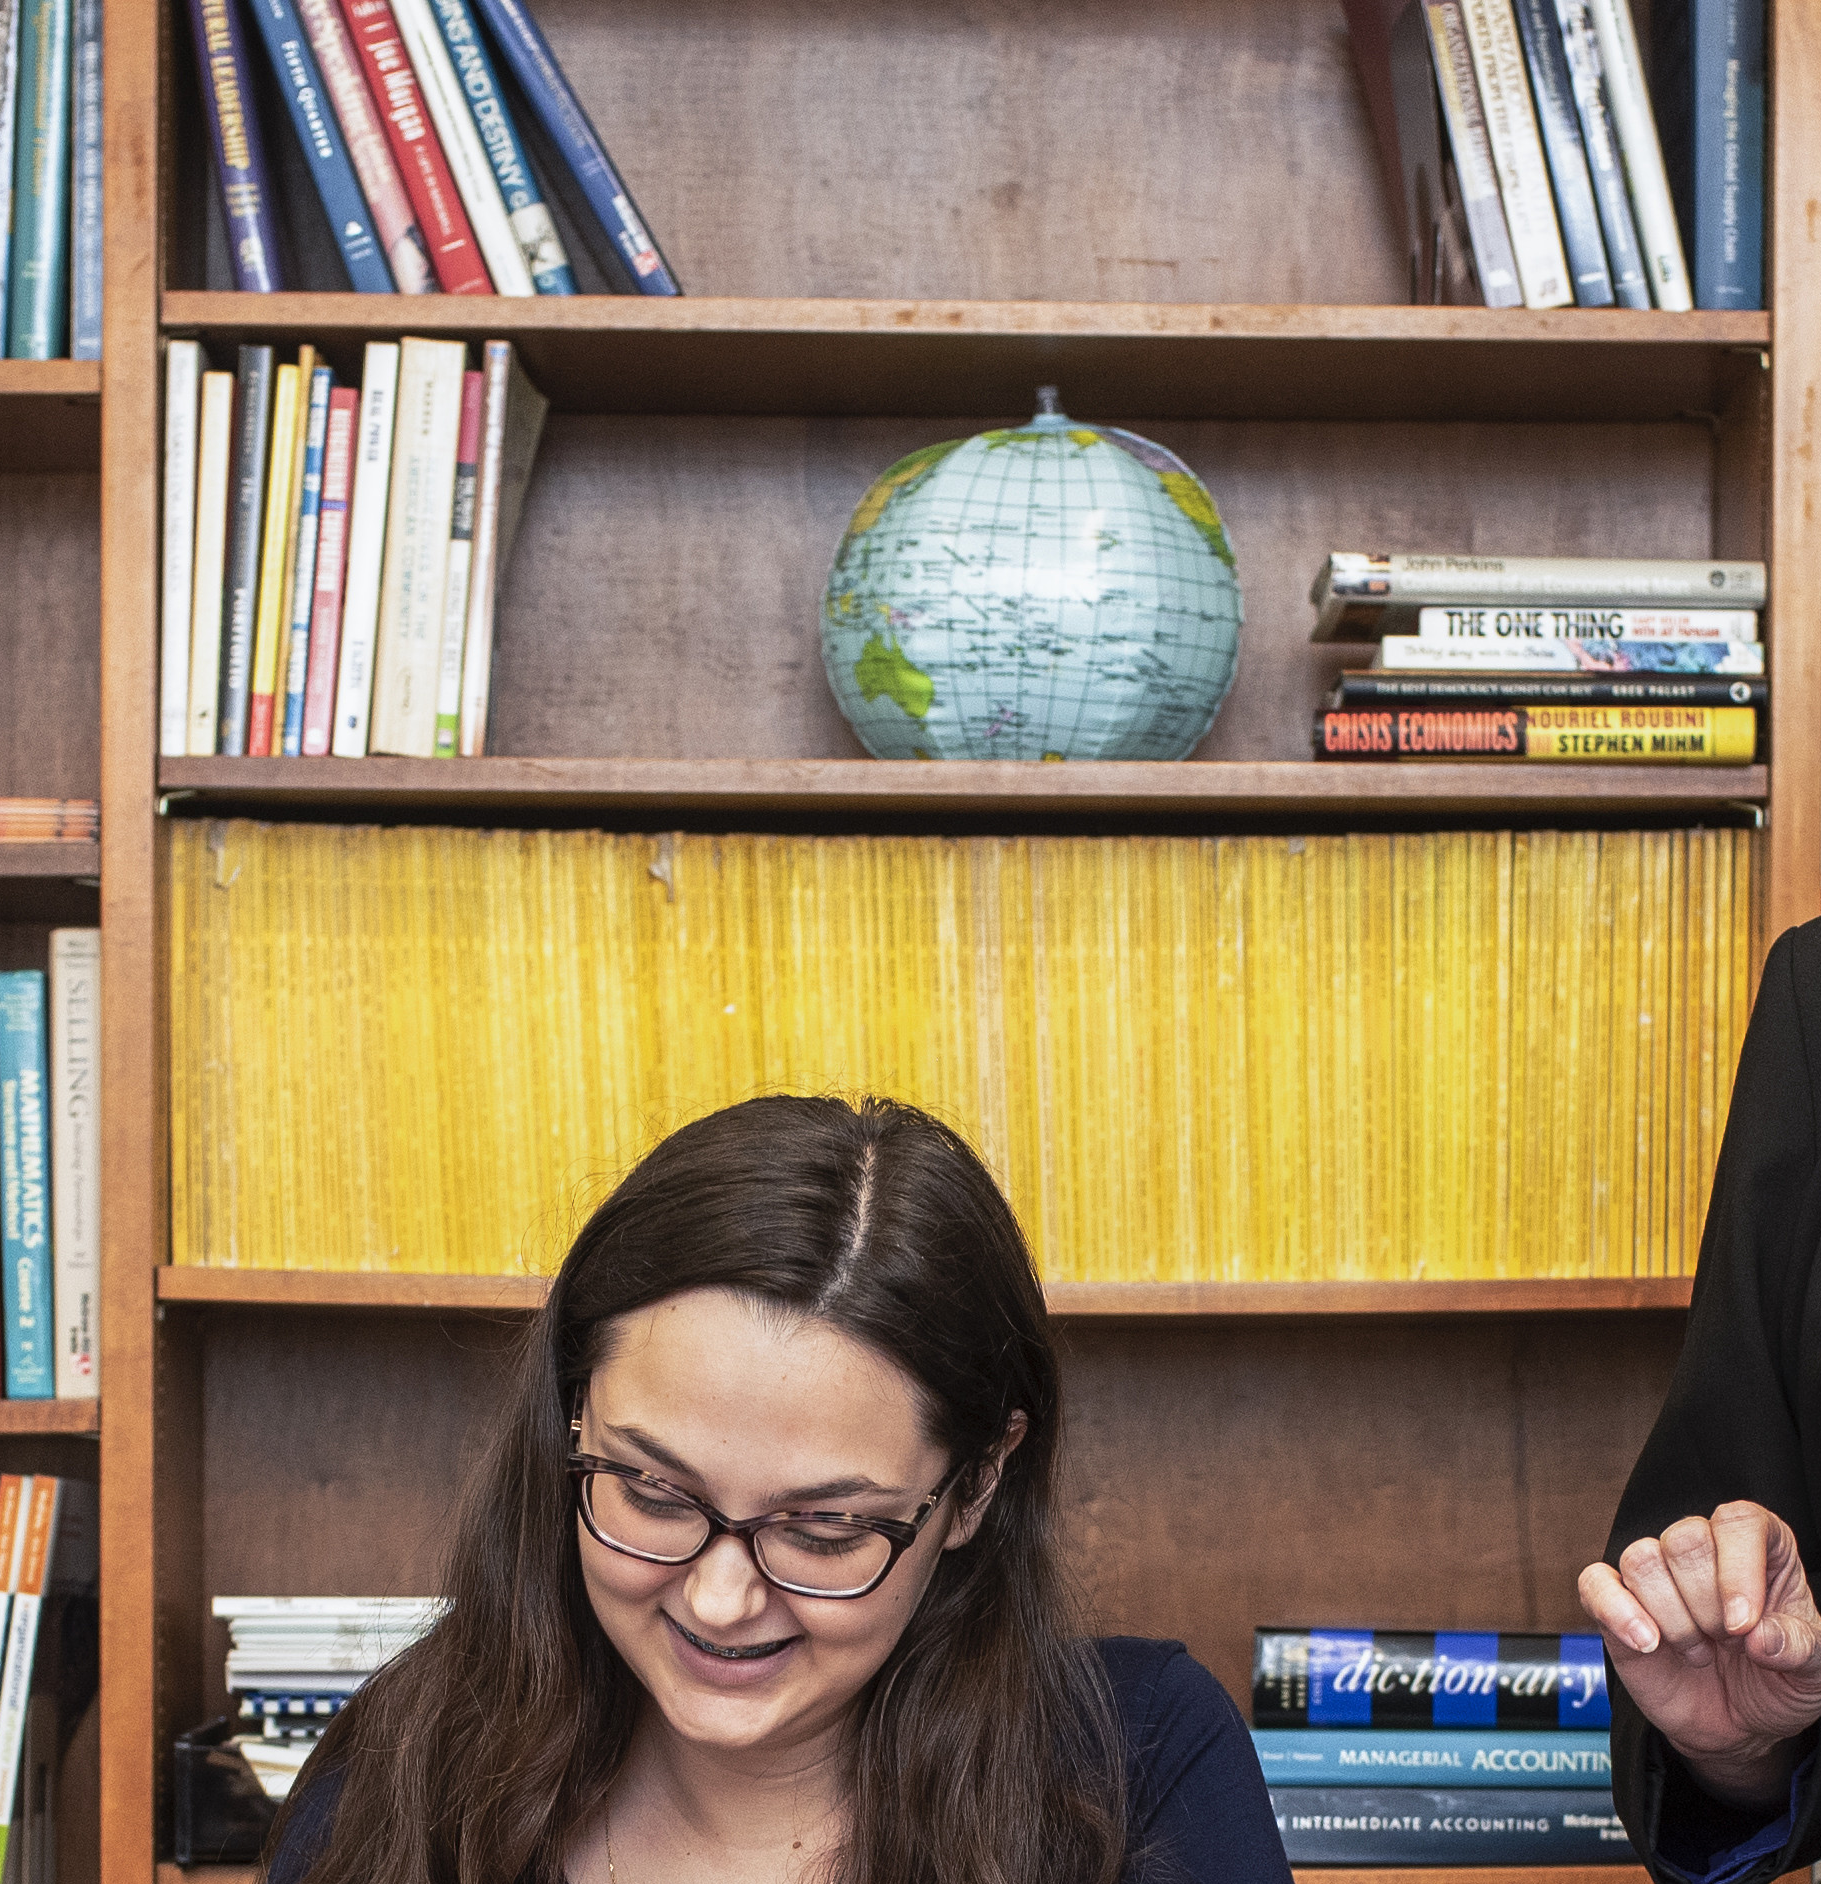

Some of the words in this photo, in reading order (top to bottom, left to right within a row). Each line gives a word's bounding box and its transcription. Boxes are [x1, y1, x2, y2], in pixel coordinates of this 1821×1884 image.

[450, 38, 493, 100] AND
[209, 54, 251, 172] LEADERSHIP
[375, 65, 431, 145] Morgan
[470, 96, 526, 193] DESTINY
[1446, 612, 1486, 638] THE
[1495, 612, 1545, 639] ONE
[1554, 613, 1624, 639] THING
[1324, 713, 1393, 751] CRISIS
[1398, 711, 1519, 751] ECONOMICS
[1558, 734, 1644, 753] STEPHEN
[1651, 734, 1705, 752] MIHM
[65, 977, 91, 1120] SELLING
[20, 1069, 46, 1250] MATHEMATICS
[1339, 1750, 1462, 1767] MANAGERIAL
[1292, 1815, 1421, 1831] INTERMEDIATE
[1430, 1817, 1549, 1832] ACCOUNTING
